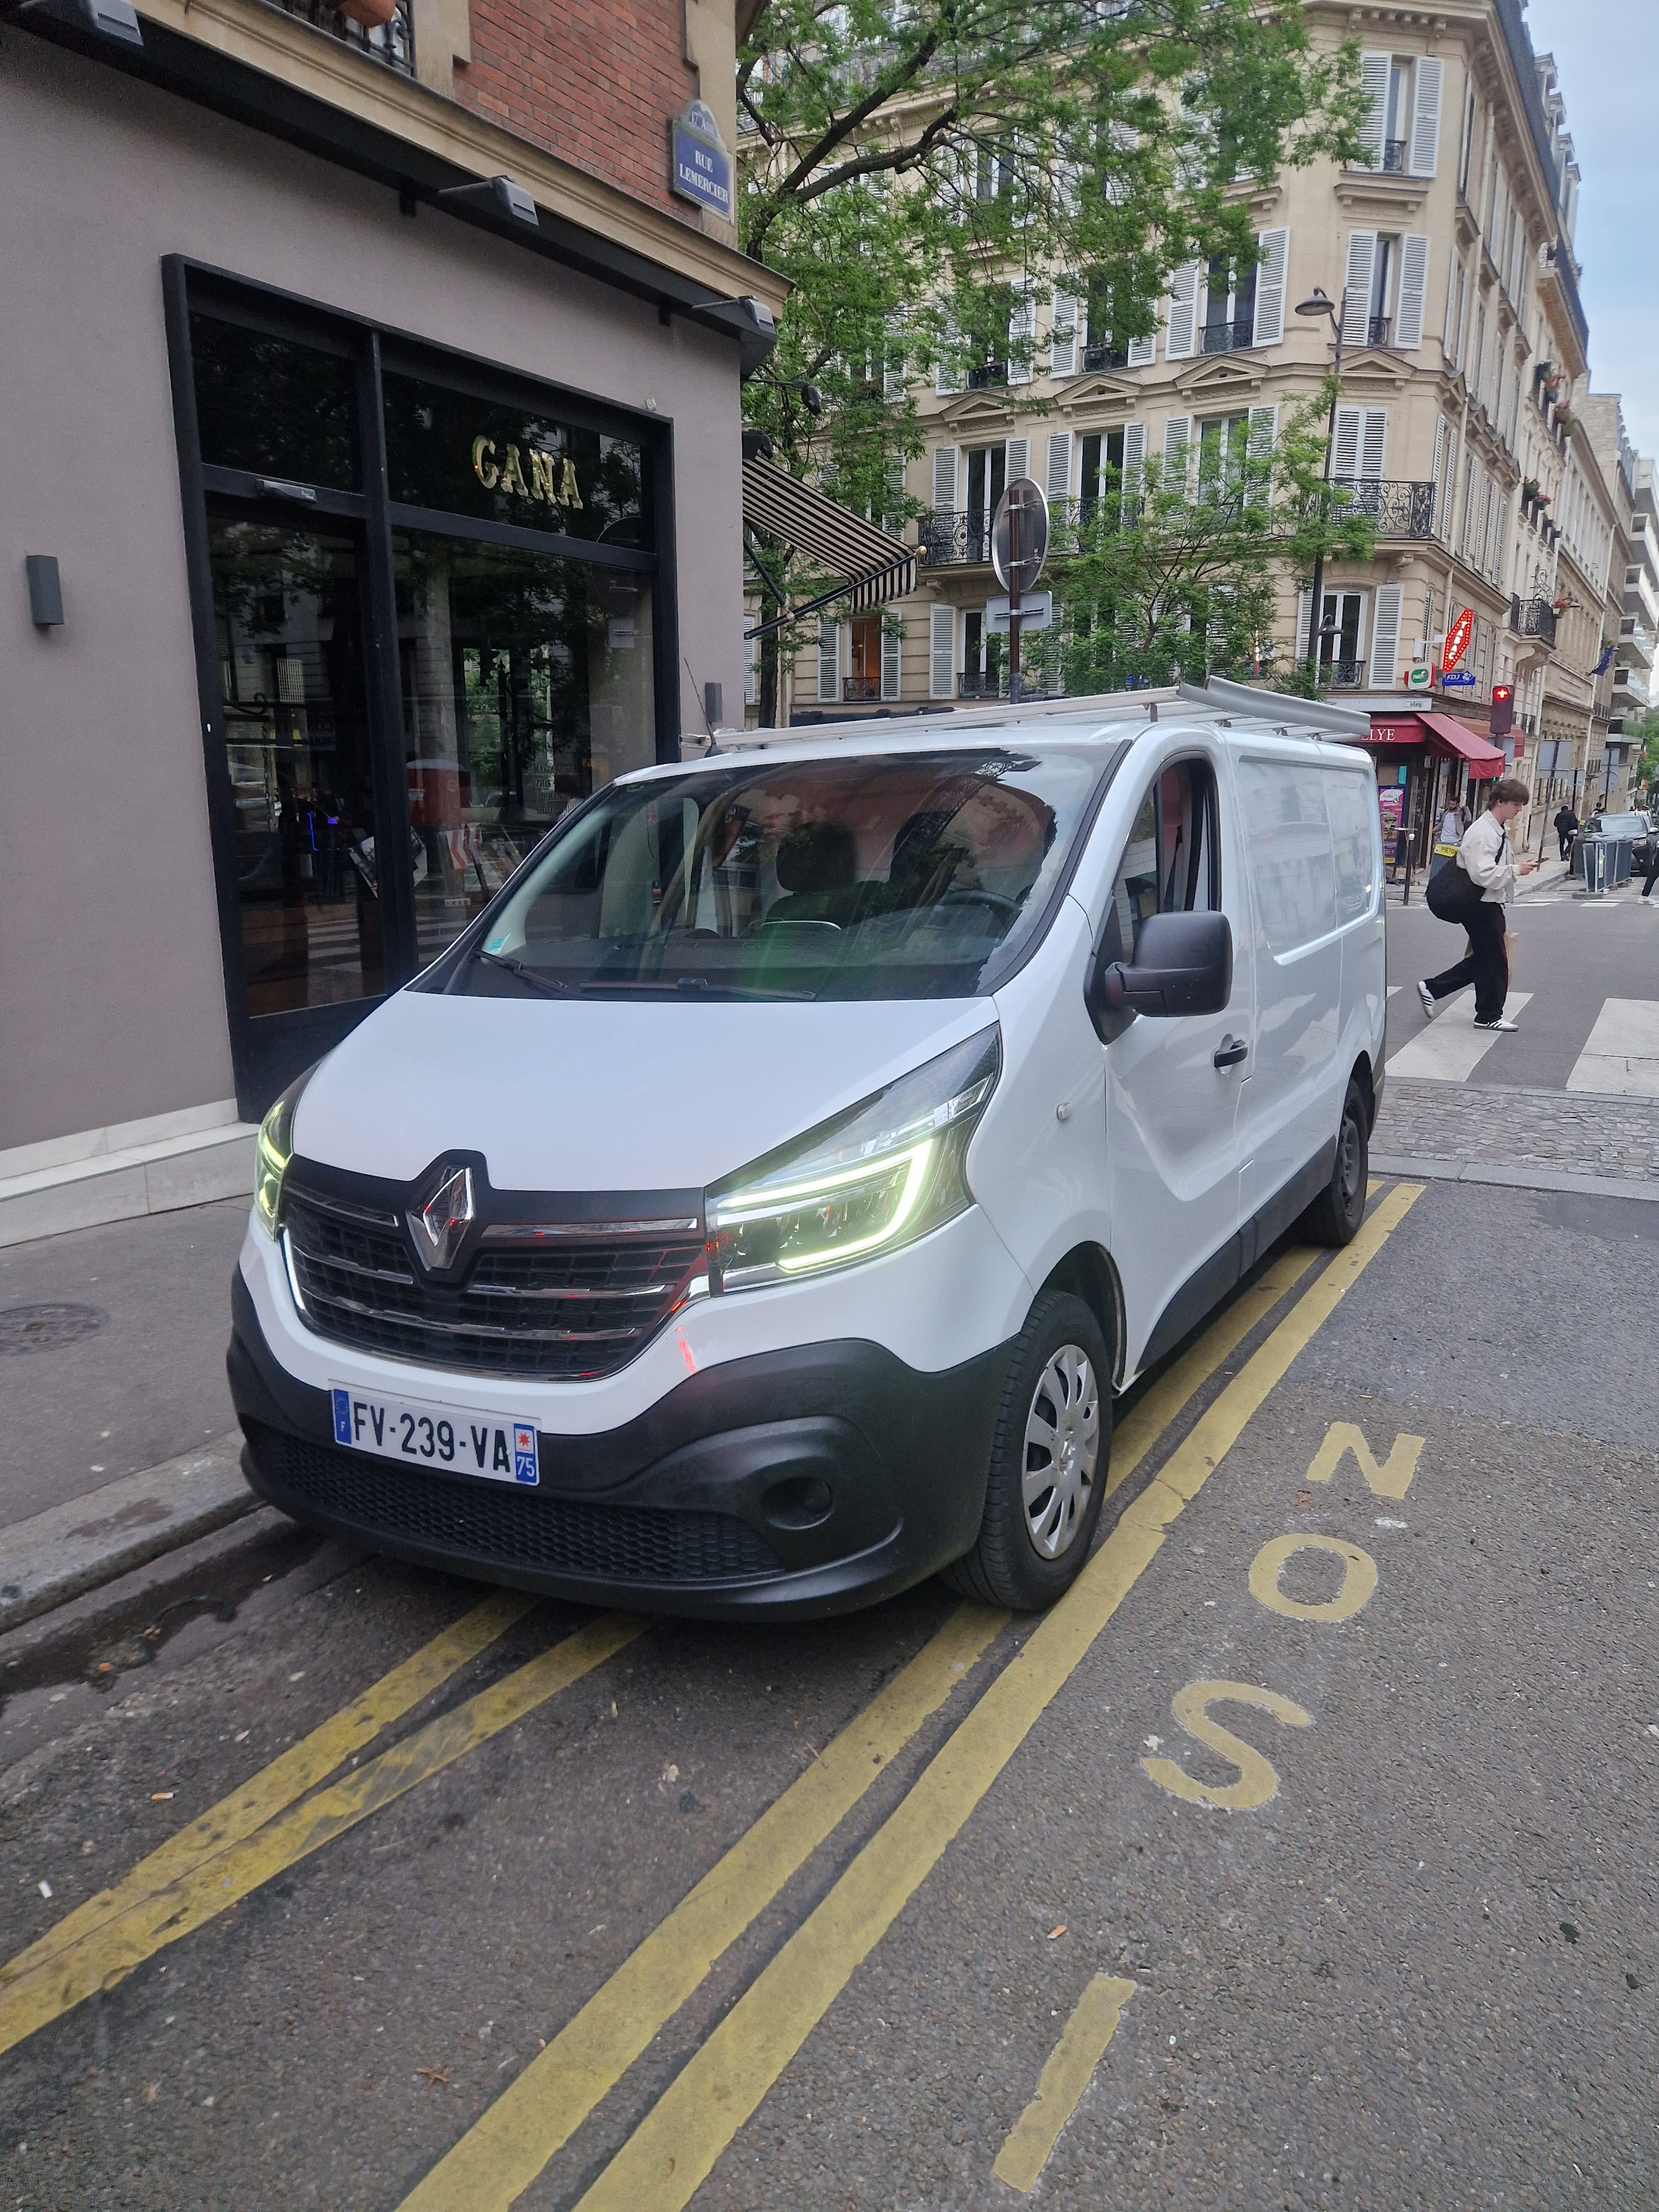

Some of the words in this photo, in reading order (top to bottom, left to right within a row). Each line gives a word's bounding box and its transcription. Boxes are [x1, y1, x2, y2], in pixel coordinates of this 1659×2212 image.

[695, 150, 713, 173] RUE
[679, 163, 728, 204] LEMERCIER
[1448, 620, 1469, 660] TABAC
[340, 1421, 346, 1432] F
[353, 1401, 511, 1473] FV-239-VA
[517, 1455, 535, 1477] 75
